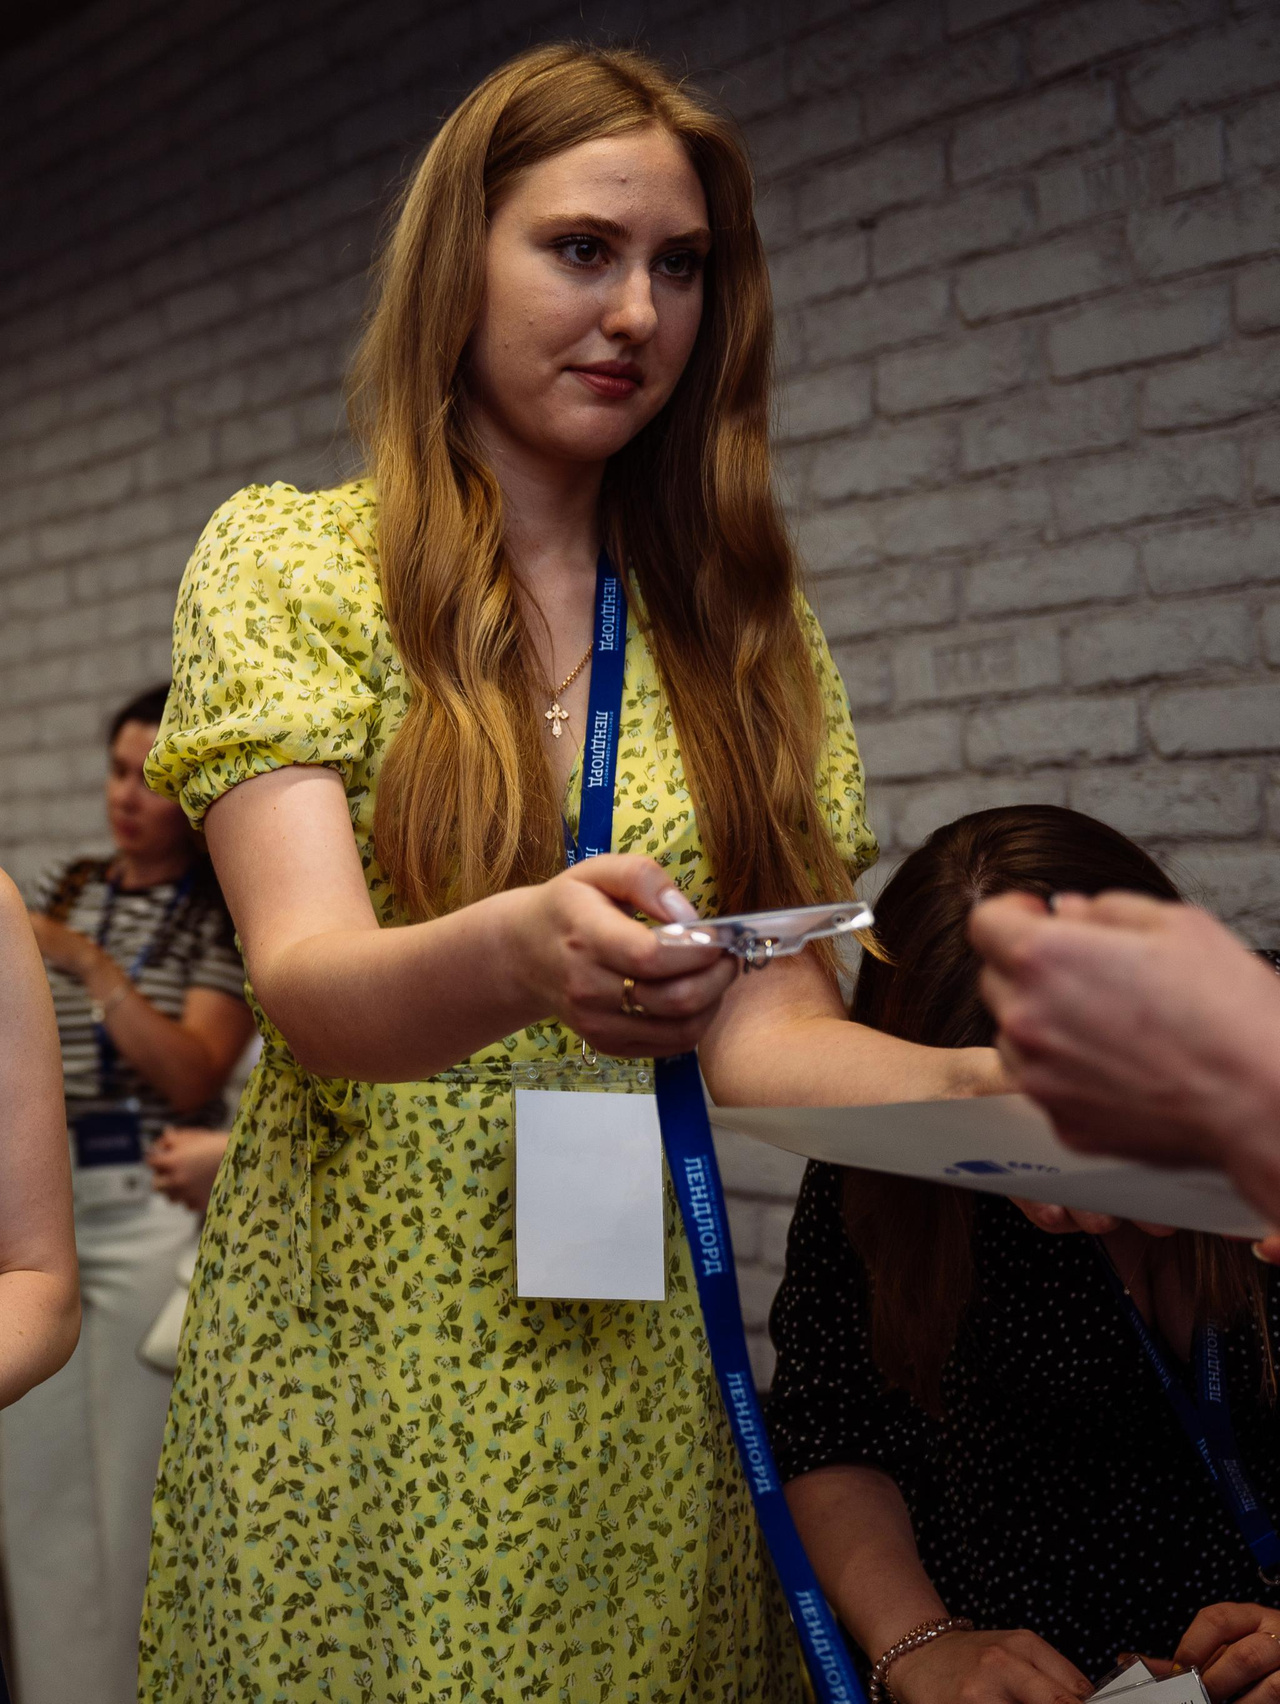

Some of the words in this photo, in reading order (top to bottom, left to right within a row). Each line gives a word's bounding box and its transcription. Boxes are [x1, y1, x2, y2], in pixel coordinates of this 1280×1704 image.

[598, 578, 617, 651] ЛЕНДЛОРД
[587, 710, 608, 788] ЛЕНДЛОРД
[683, 1156, 723, 1276] ЛЕНДЛОРД
[726, 1372, 772, 1495] ЛЕНДЛОРД
